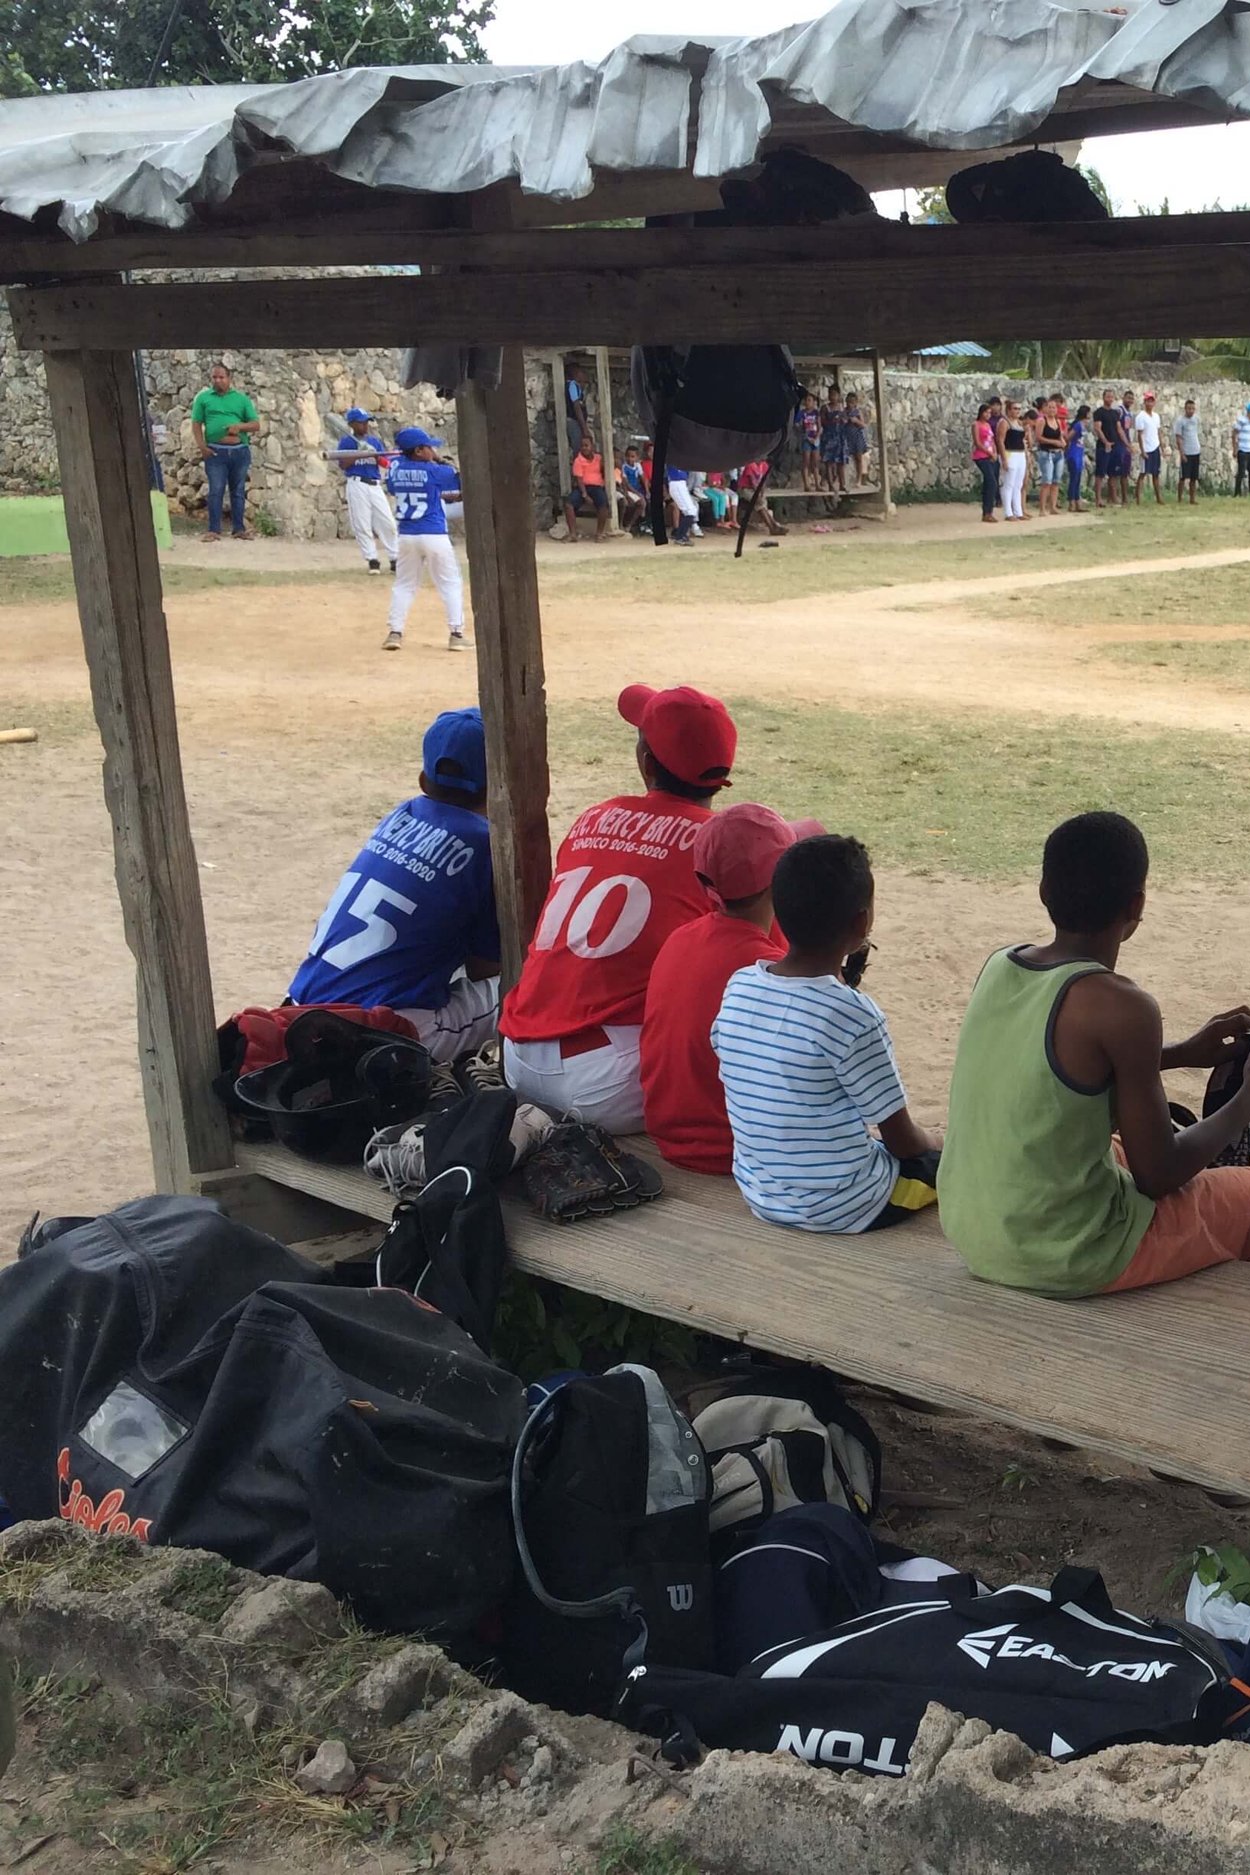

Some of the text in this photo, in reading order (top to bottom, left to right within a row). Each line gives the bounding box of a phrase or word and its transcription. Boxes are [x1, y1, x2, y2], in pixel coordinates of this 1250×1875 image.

[412, 828, 474, 877] BRITO
[571, 838, 669, 860] SINDICO 2016-2020
[591, 806, 654, 840] NERCY
[641, 815, 703, 851] BRITO
[383, 847, 436, 882] 2016-2020
[308, 872, 418, 971] 15
[536, 866, 652, 959] 10
[777, 1723, 912, 1775] TON
